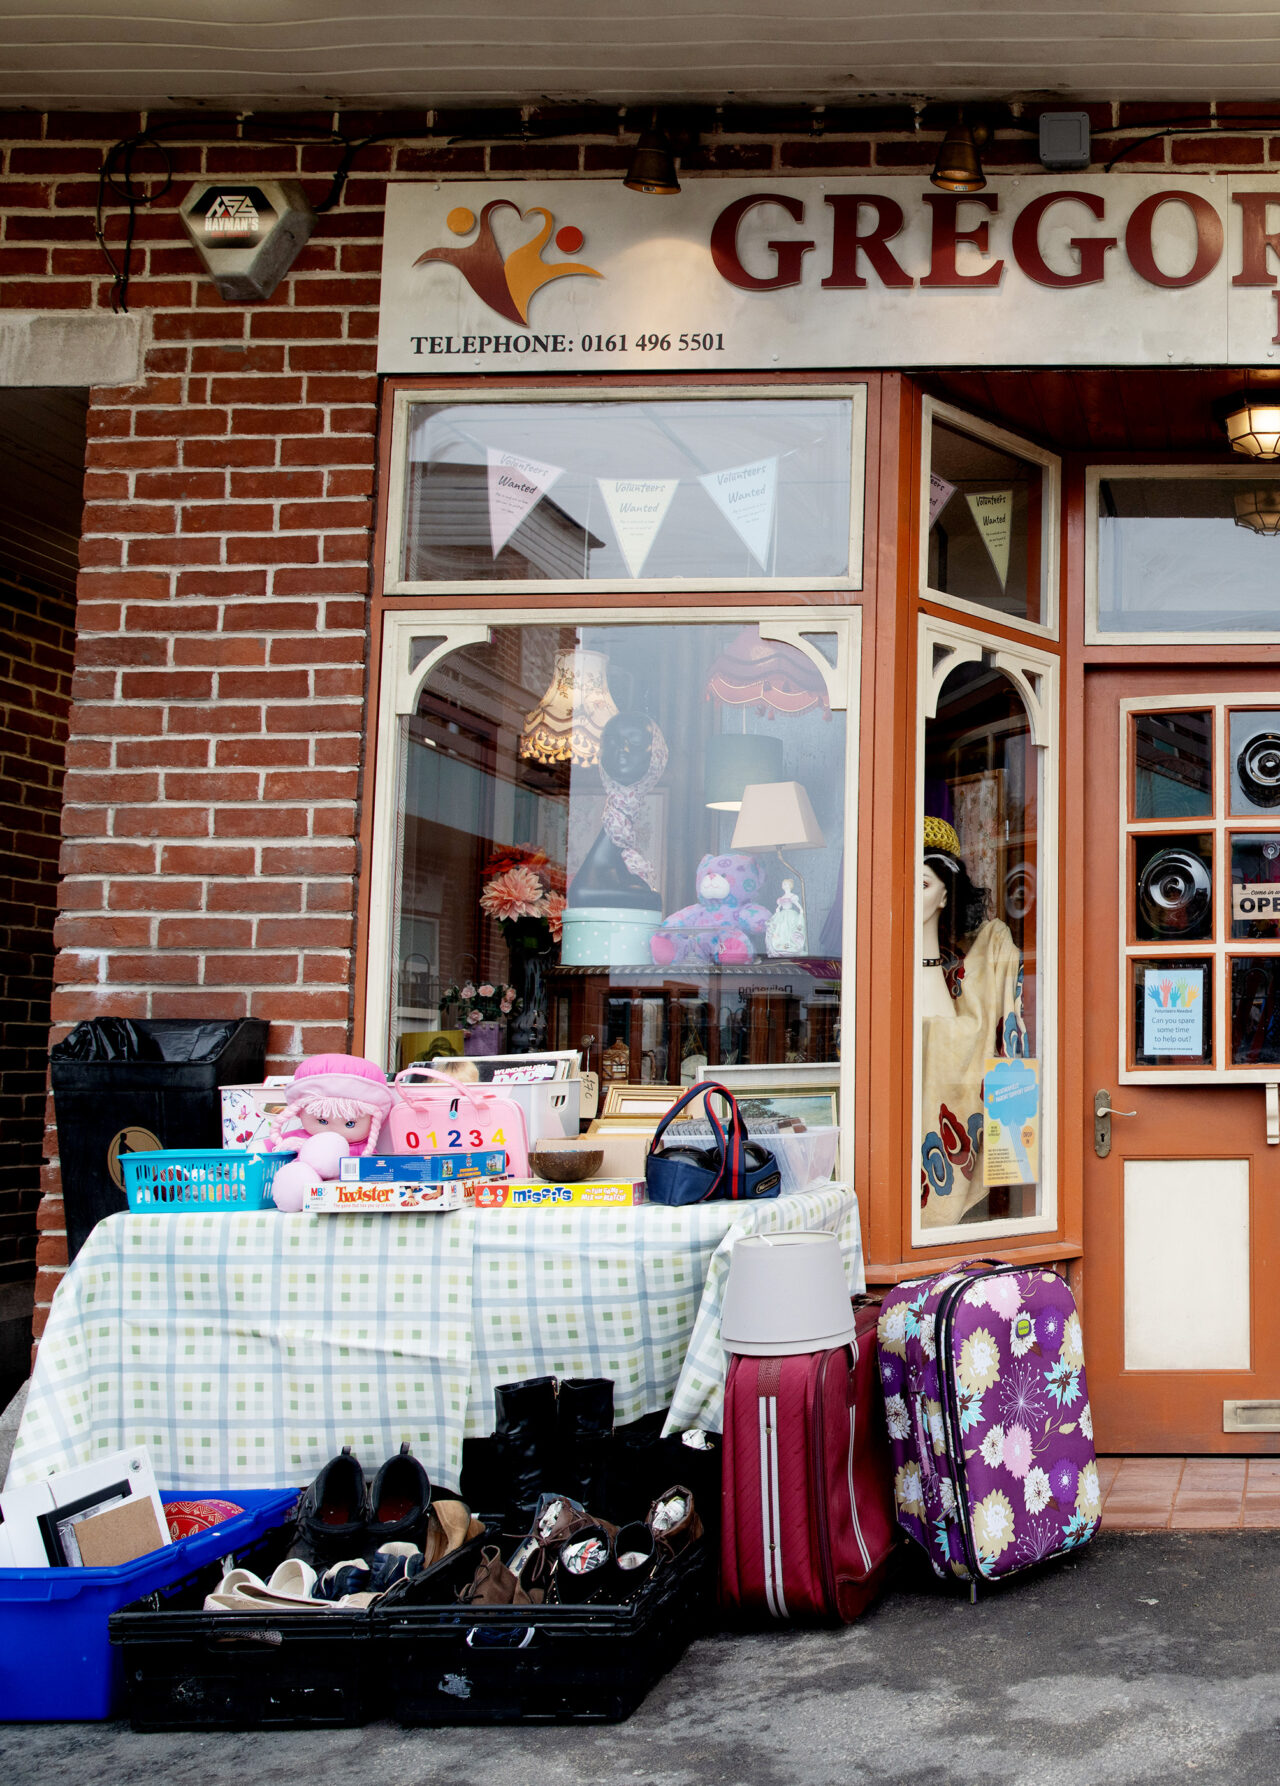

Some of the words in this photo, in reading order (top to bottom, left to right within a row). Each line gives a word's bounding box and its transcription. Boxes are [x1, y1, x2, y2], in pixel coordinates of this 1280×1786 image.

[204, 217, 260, 231] HAYMAN'S
[410, 334, 574, 354] TELEPHONE:
[581, 333, 628, 352] 0161
[635, 333, 671, 352] 496
[678, 332, 725, 351] 5501
[500, 453, 549, 477] Volunteers
[717, 465, 767, 485] Volunteers
[498, 474, 538, 495] Wanted
[615, 481, 666, 493] Volunteers
[728, 483, 766, 503] Wanted
[976, 494, 1006, 507] Volunteers
[619, 502, 660, 513] Wanted
[982, 513, 1006, 526] Wanted
[1162, 1035, 1177, 1043] help
[406, 1131, 420, 1149] 0
[426, 1131, 438, 1149] 1
[447, 1130, 462, 1147] 2
[469, 1130, 483, 1147] 3
[491, 1128, 507, 1146] 4
[311, 1187, 323, 1197] MB
[335, 1185, 394, 1203] Twister
